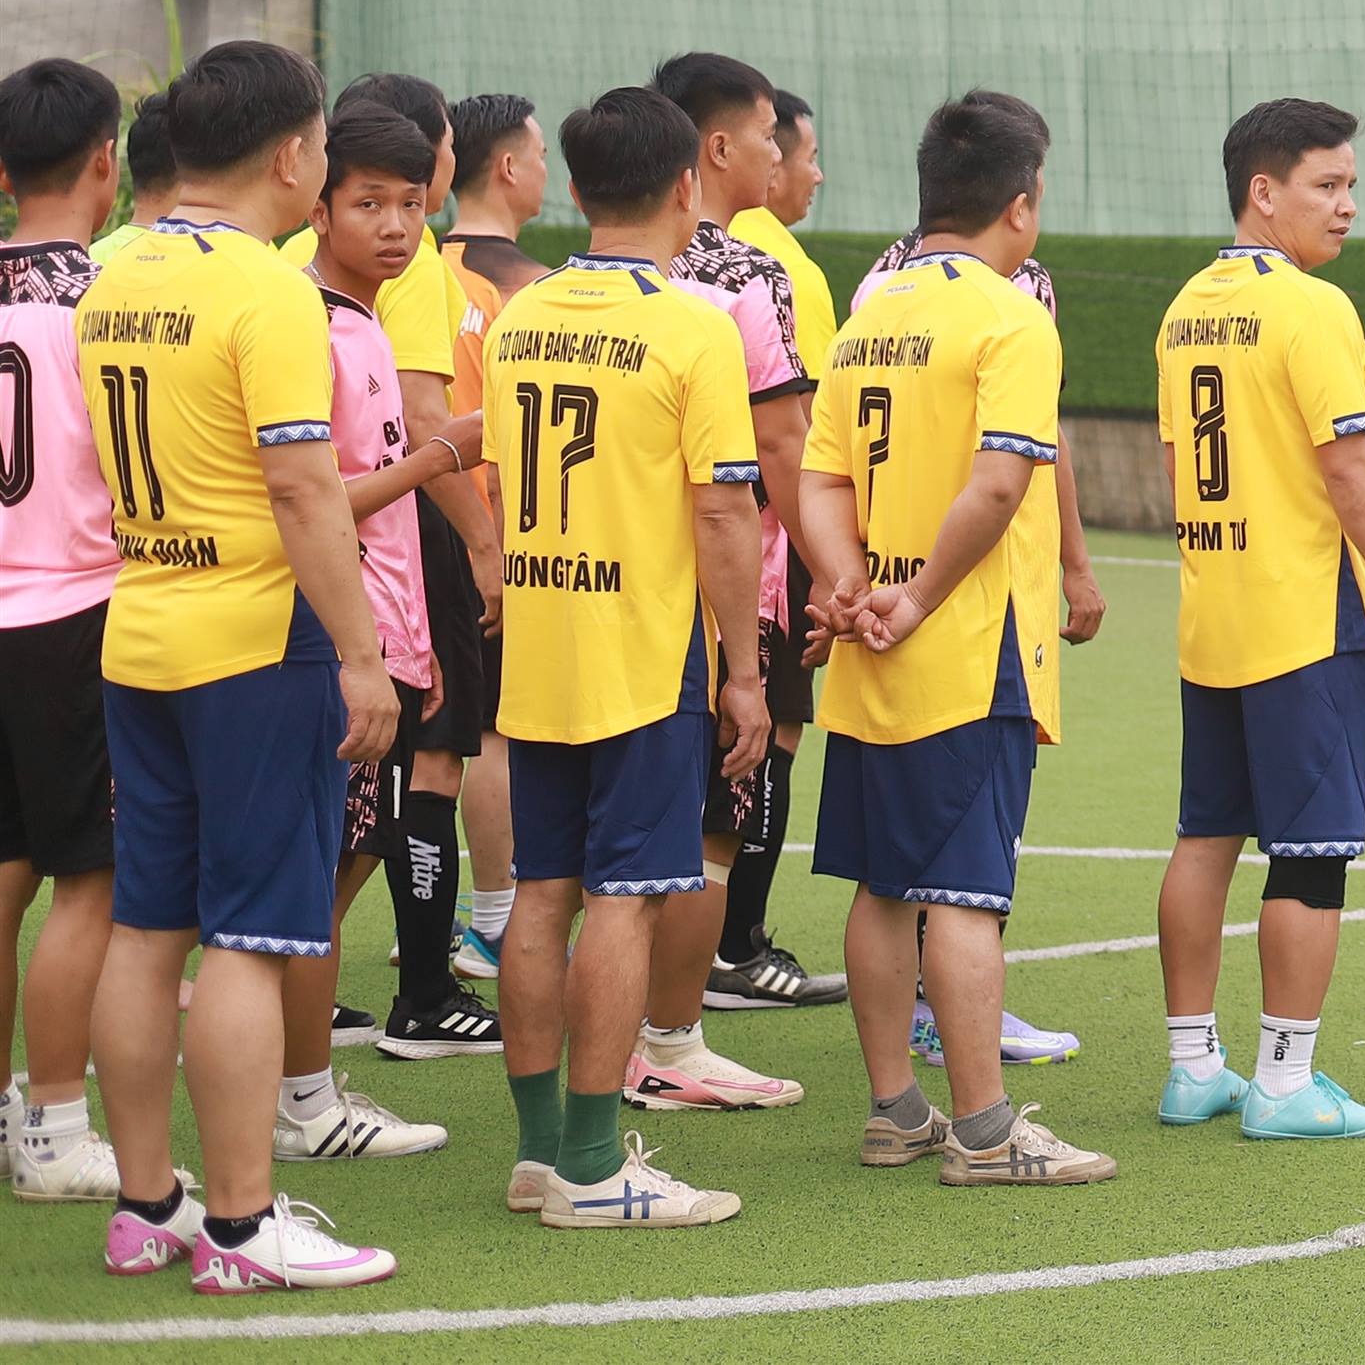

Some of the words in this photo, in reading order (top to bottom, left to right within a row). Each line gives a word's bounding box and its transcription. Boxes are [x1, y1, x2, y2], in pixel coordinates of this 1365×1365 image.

[511, 330, 544, 365] QUAN
[606, 334, 648, 378] TRẬN
[100, 365, 166, 522] 11
[516, 382, 599, 535] 17
[1190, 365, 1229, 502] 8
